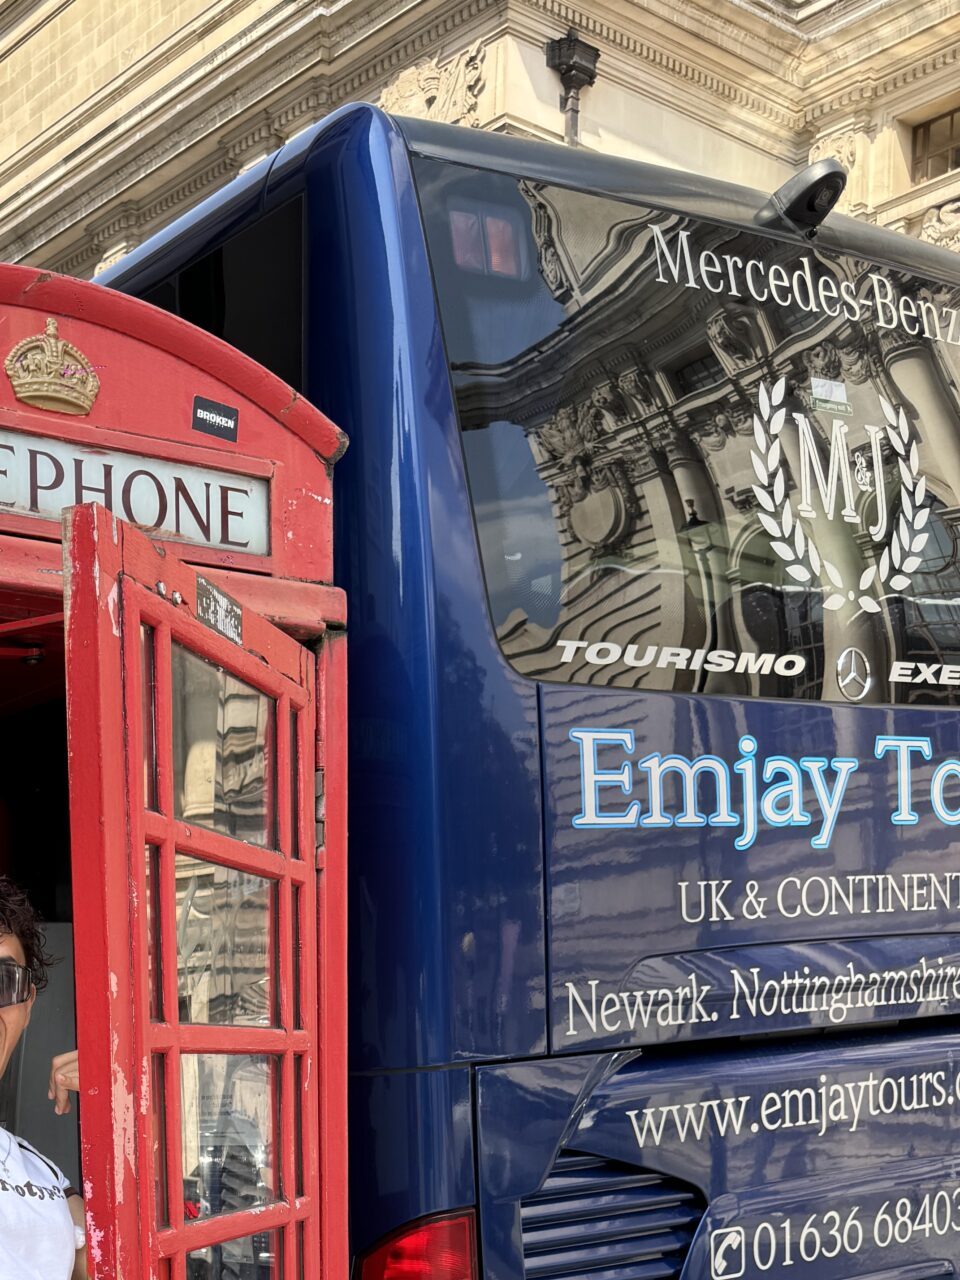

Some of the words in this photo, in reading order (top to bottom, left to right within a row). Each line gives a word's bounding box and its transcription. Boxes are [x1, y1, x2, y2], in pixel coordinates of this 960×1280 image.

[648, 224, 960, 346] Mercedes-Benz
[197, 409, 235, 429] BROKEN
[556, 639, 807, 677] TOURISMO
[888, 661, 960, 686] EXE
[569, 727, 858, 850] Emjay
[874, 735, 960, 826] To
[678, 879, 734, 922] UK
[742, 880, 768, 919] &
[565, 973, 719, 1036] Newark.
[730, 957, 960, 1024] Nottinghamshire
[625, 1071, 960, 1149] www.emjaytours.
[753, 1207, 864, 1270] 01636
